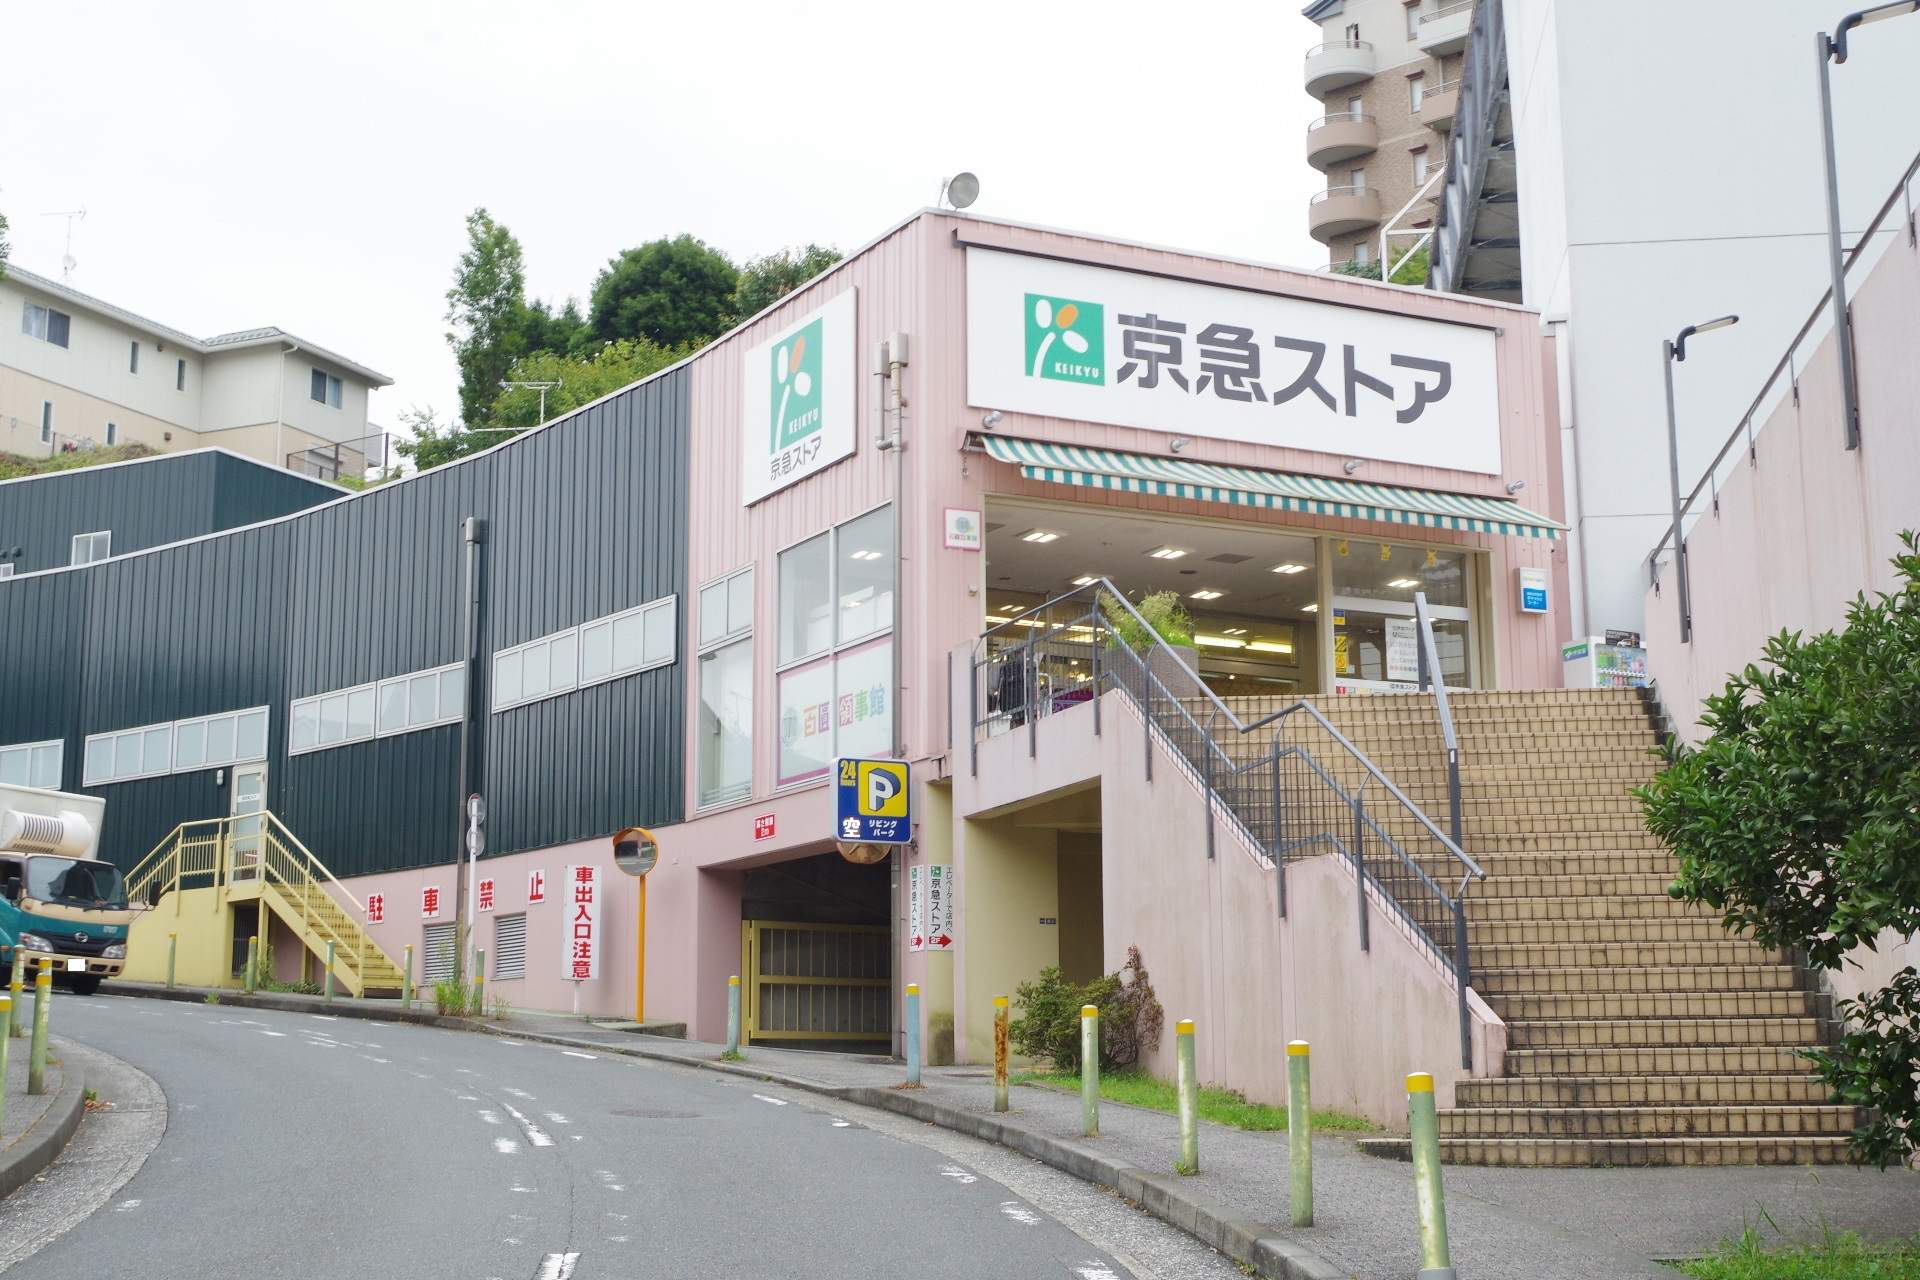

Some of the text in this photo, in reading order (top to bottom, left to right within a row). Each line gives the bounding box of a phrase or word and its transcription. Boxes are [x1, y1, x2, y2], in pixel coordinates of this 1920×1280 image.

[1055, 362, 1099, 378] KEIKYU
[1116, 312, 1451, 424] 京急ストア
[770, 436, 821, 480] 京急ストア
[841, 760, 856, 779] 24
[868, 769, 899, 811] P
[843, 817, 861, 838] 空
[869, 819, 898, 829] リビング
[873, 829, 895, 838] パーク
[931, 878, 941, 934] 京急ストア
[572, 866, 594, 979] 車出入口注意
